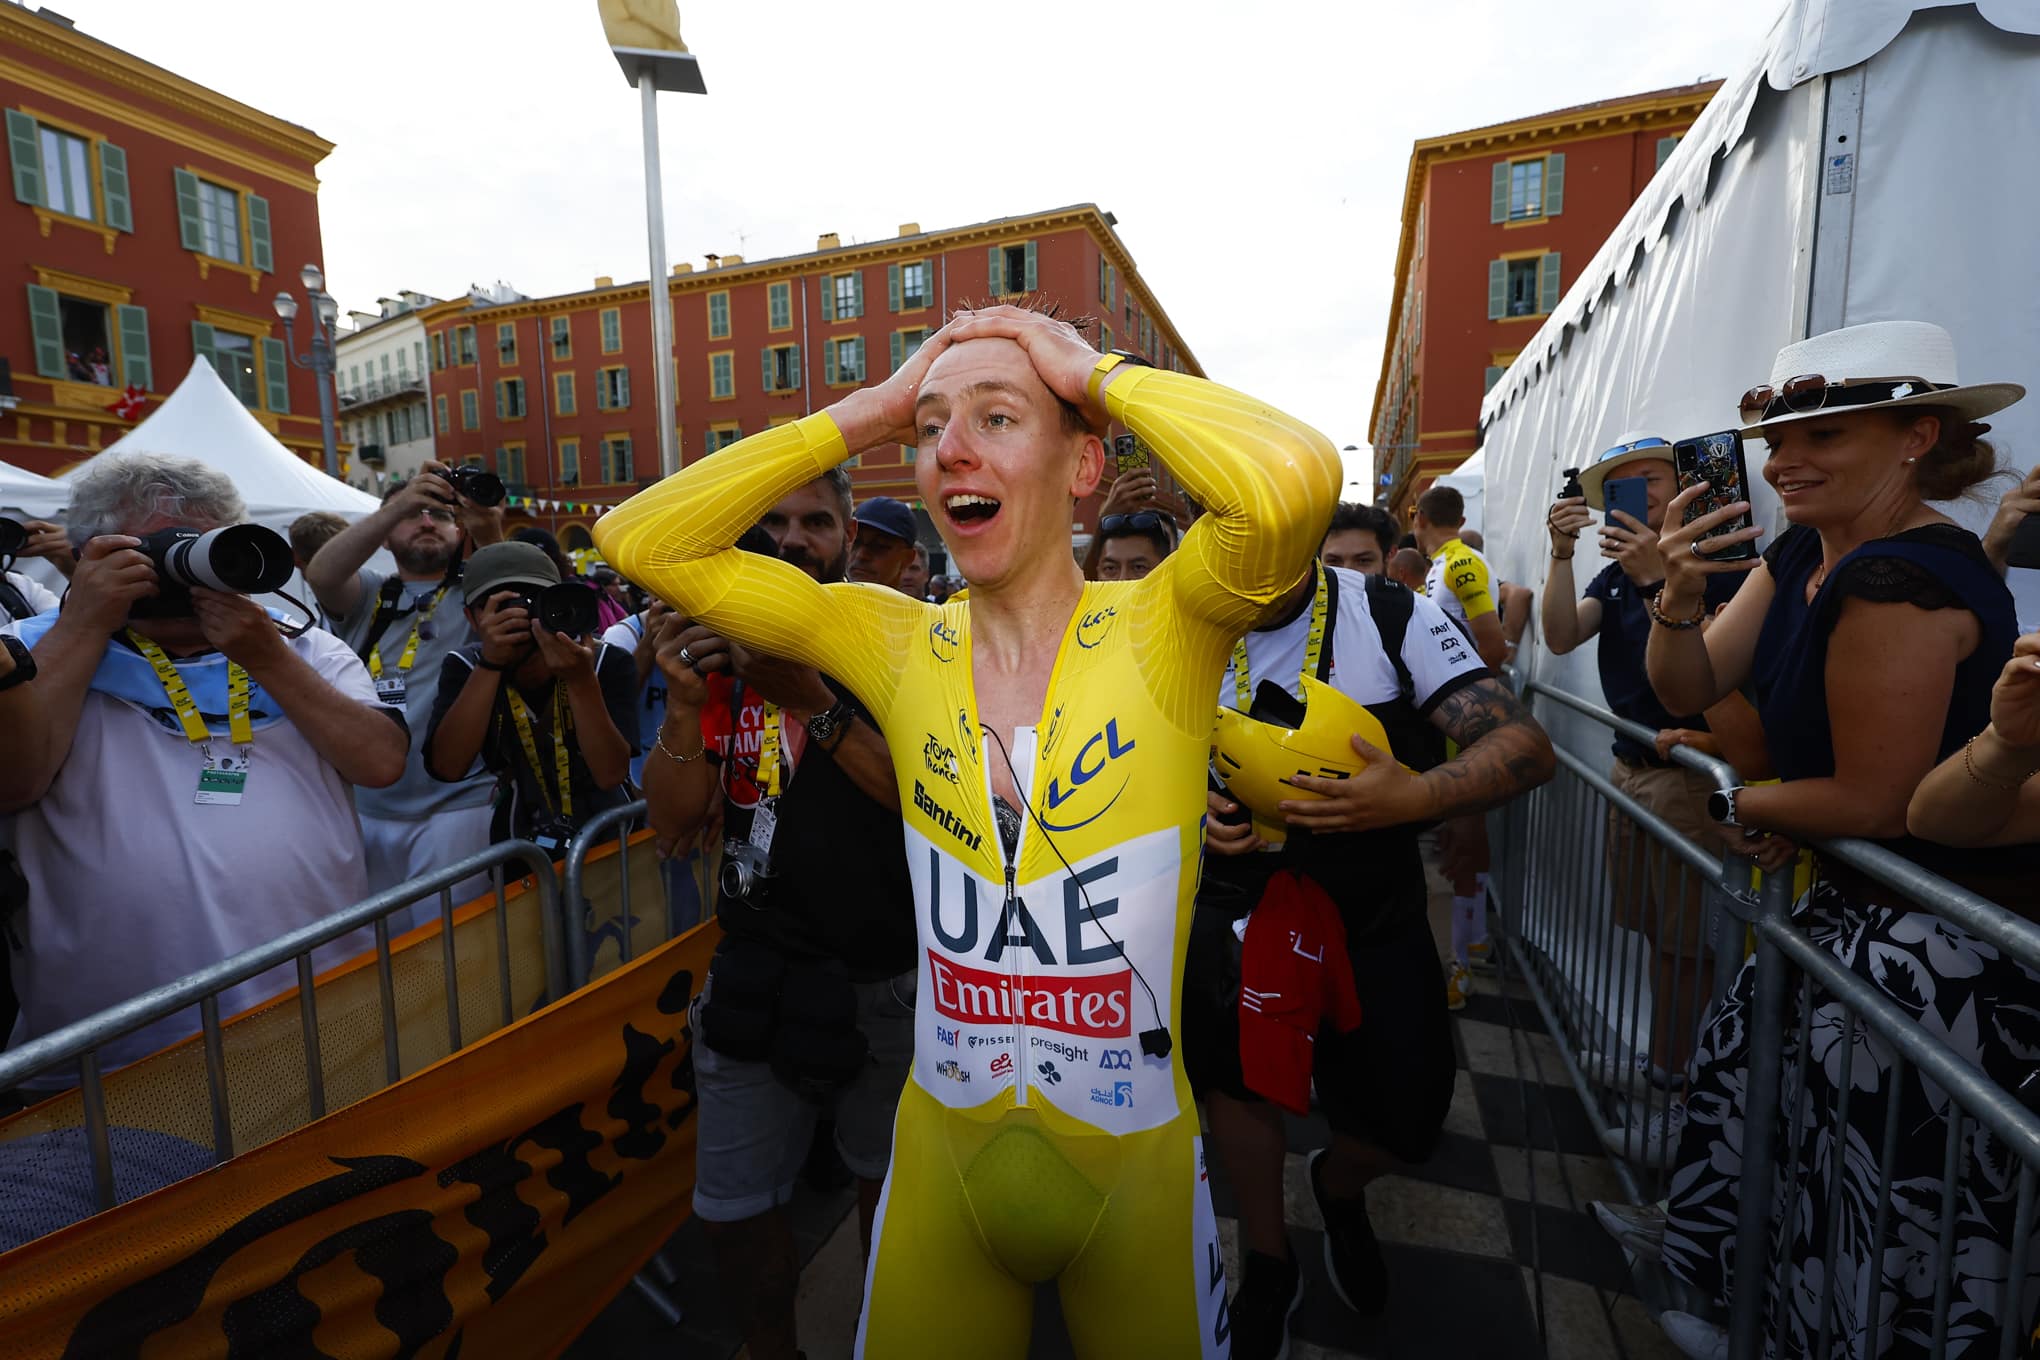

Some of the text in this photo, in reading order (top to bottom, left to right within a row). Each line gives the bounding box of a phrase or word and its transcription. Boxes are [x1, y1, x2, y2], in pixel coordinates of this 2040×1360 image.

[1049, 717, 1136, 810] LCL
[913, 778, 982, 852] Santini
[929, 846, 1125, 966] UAE
[934, 957, 1130, 1029] Emirates
[1031, 1036, 1089, 1062] presight
[1099, 1049, 1132, 1070] ADQ
[1090, 1095, 1113, 1106] ADNOC
